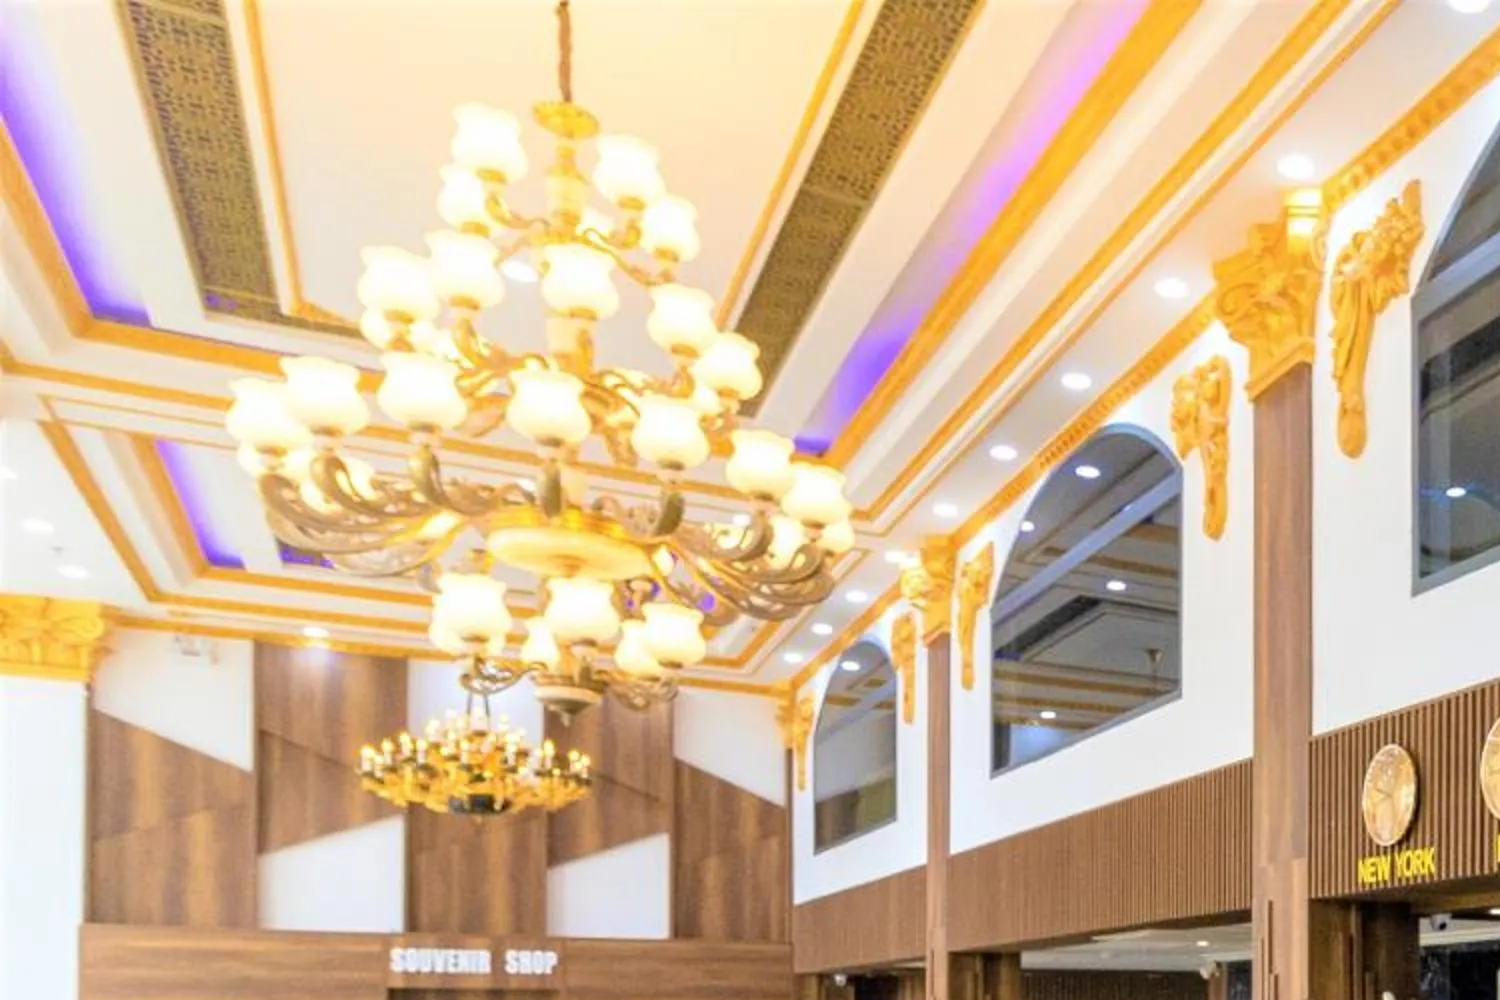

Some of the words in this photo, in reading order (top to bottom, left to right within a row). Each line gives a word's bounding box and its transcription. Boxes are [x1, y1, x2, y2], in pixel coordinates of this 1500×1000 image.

[1358, 855, 1390, 884] NEW
[1394, 847, 1436, 878] YORK
[390, 947, 491, 973] SOUVENIR
[505, 950, 558, 975] SHOP
